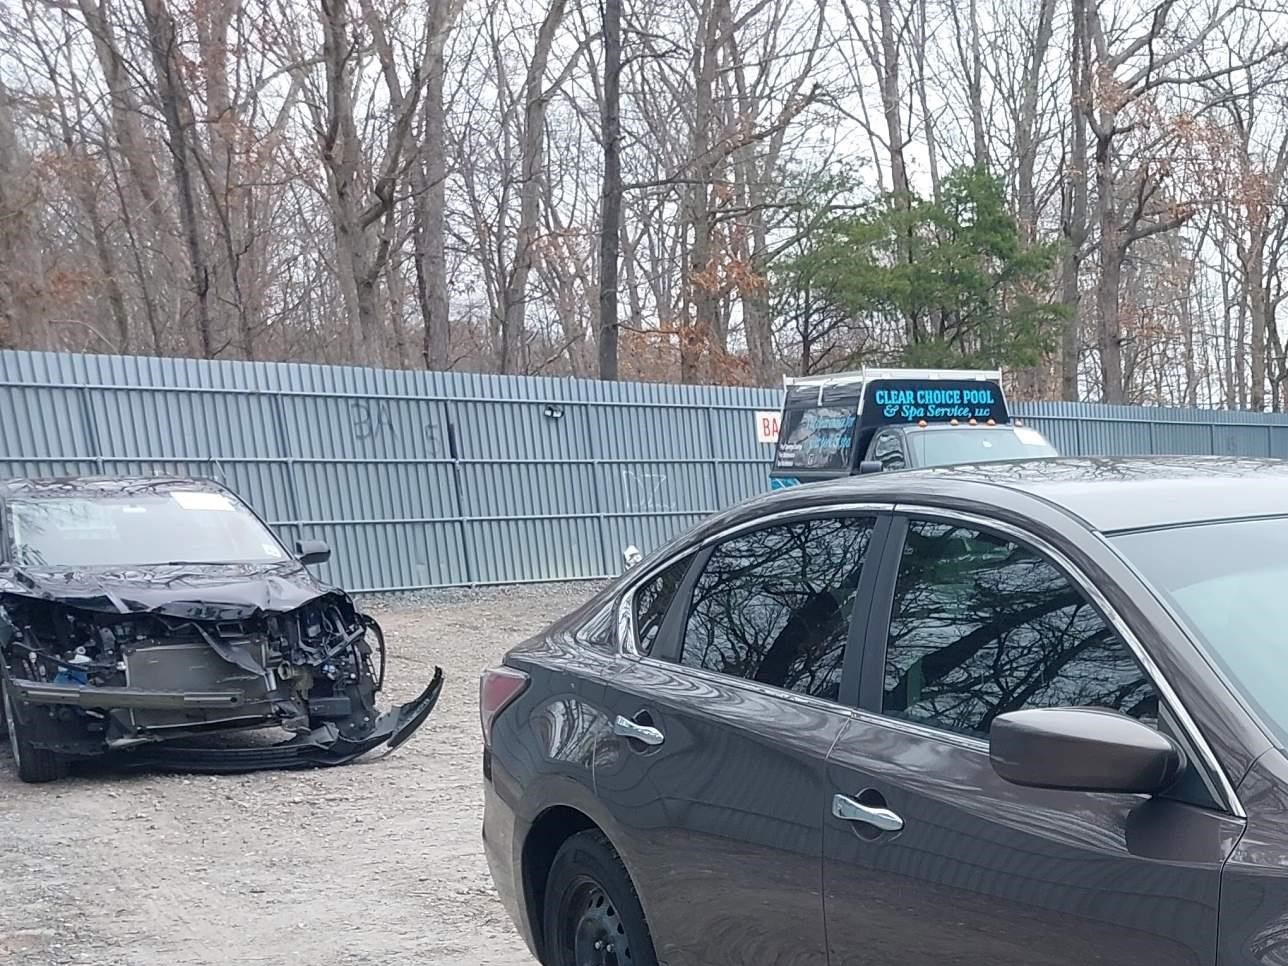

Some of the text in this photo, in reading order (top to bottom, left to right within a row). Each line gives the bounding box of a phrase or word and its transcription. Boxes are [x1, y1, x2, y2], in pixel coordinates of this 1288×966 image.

[876, 390, 994, 405] CLEAR CHOICE POOL
[884, 405, 899, 417] &
[901, 404, 924, 420] Spa
[927, 405, 971, 418] Service,
